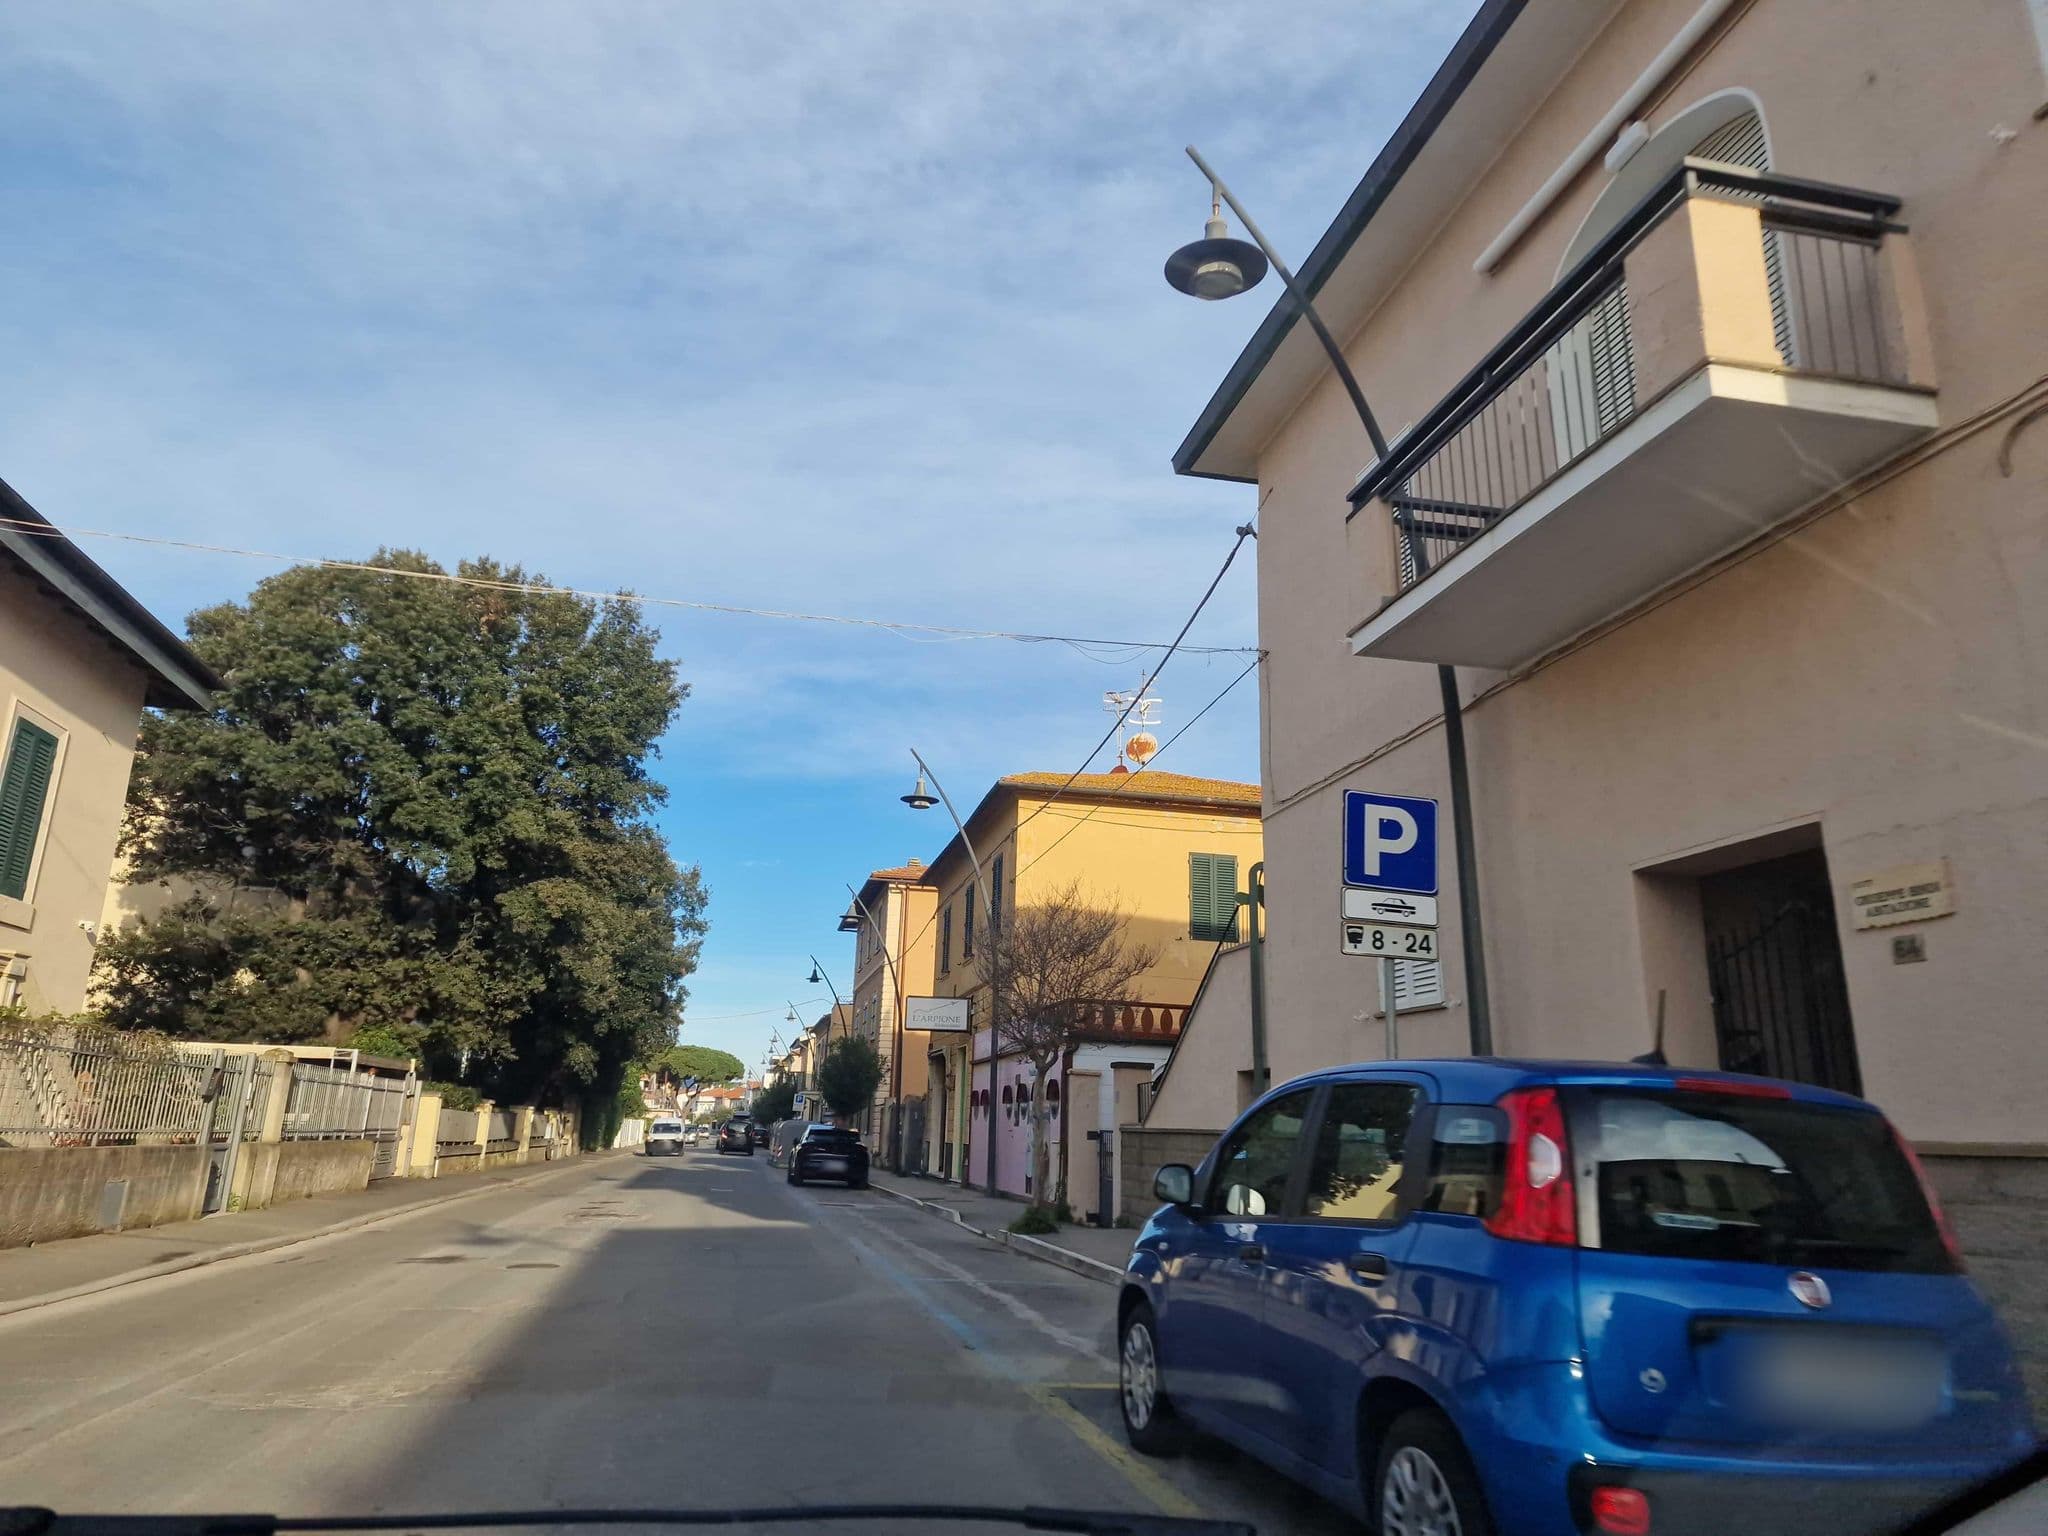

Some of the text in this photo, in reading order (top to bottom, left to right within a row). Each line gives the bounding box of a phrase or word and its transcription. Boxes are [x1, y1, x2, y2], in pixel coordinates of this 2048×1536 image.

[1364, 803, 1418, 877] P
[1372, 930, 1385, 950] 8
[1405, 932, 1432, 954] 24
[912, 1014, 961, 1023] L'ARPIONE
